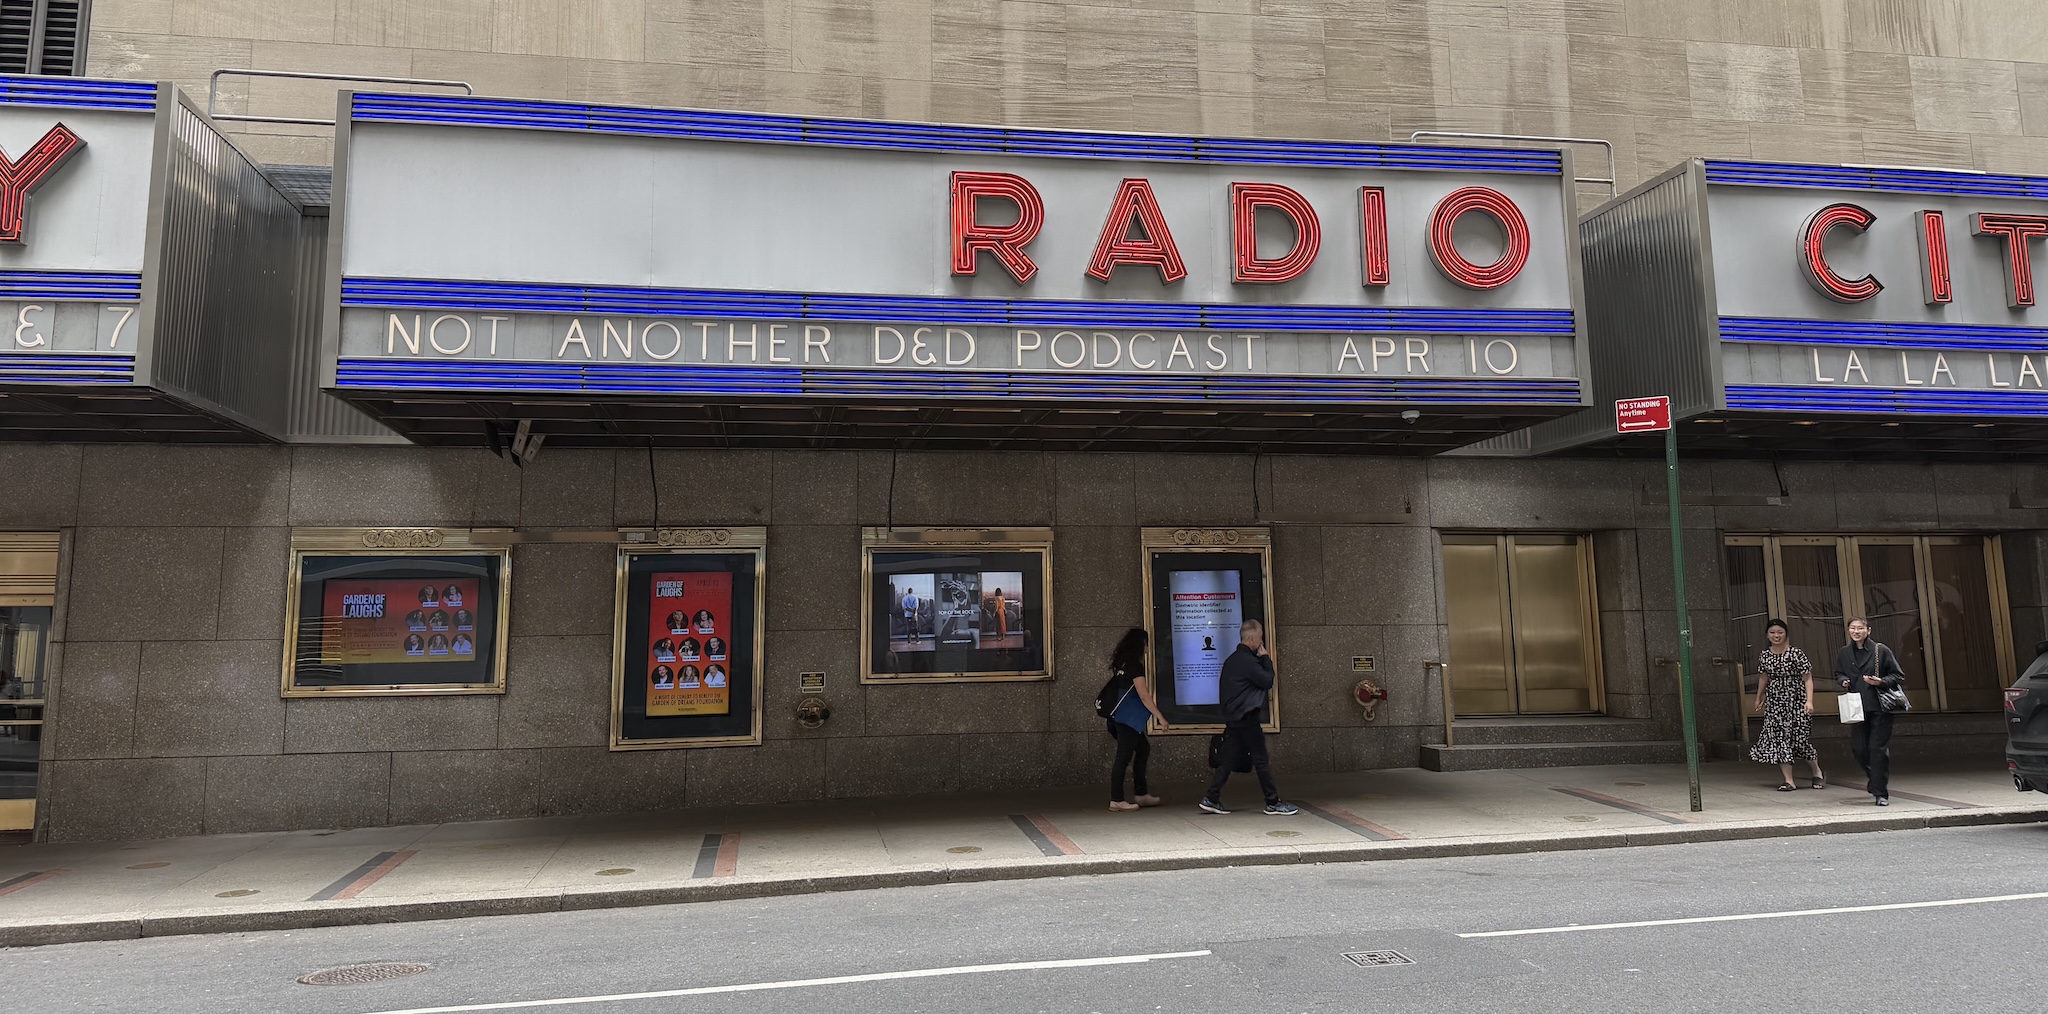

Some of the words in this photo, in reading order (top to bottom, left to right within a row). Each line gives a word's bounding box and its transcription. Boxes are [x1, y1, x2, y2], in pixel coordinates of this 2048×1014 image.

[0, 121, 88, 246] Y
[948, 170, 1531, 292] RADIO
[1795, 202, 2048, 309] CIT
[15, 304, 46, 348] &
[107, 306, 135, 349] 7
[387, 313, 510, 356] NOT
[557, 318, 832, 363] ANOTHER
[874, 326, 977, 366] D&D
[1015, 329, 1261, 371] PODCAST
[1337, 336, 1430, 373] APR
[1813, 348, 1869, 383] LA
[1901, 351, 1957, 386] LA
[1988, 353, 2048, 388] LA
[1618, 402, 1629, 410] NO
[1629, 400, 1661, 410] STANDING
[1620, 409, 1647, 418] Anytime
[656, 580, 677, 589] GARDEN
[676, 580, 684, 588] OF
[656, 587, 683, 598] LAUGHS
[342, 604, 384, 618] LAUGHS
[343, 594, 374, 605] GARDEN
[375, 594, 386, 605] OF
